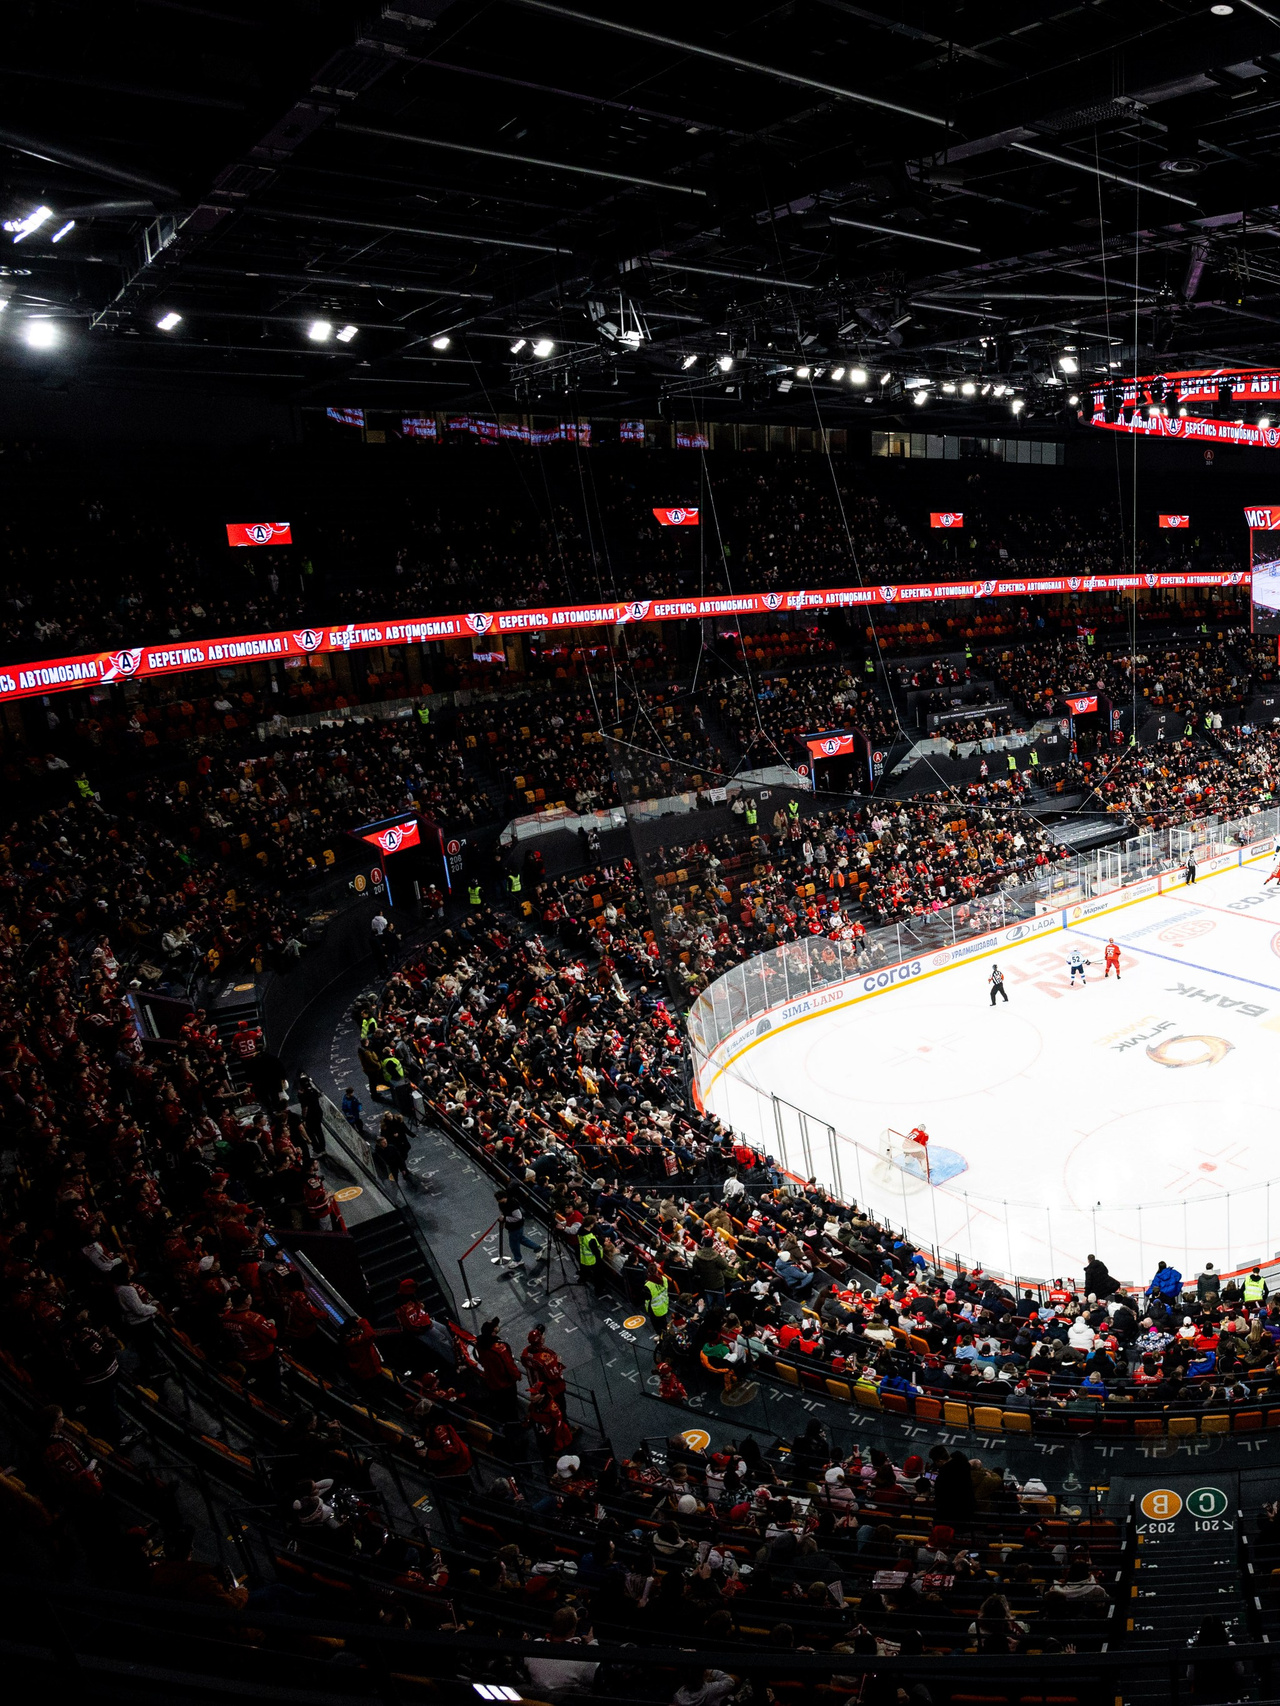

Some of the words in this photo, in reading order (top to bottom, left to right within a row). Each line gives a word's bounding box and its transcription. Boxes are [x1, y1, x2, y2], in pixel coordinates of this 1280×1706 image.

[1185, 422, 1216, 436] БЕРЕГИСЬ
[1219, 426, 1258, 441] АВТОМОБИЛЯ
[654, 602, 696, 616] БЕРЕГИСЬ
[700, 600, 753, 613] АВТОМОБИЛЯ
[787, 594, 823, 606] БЕРЕГИСЬ
[500, 613, 548, 628] БЕРЕГИСЬ
[552, 609, 614, 624] АВТОМОБИЛЯ
[330, 628, 382, 646] БЕРЕГИСЬ
[386, 620, 454, 640] АВТОМОБИЛЯ
[148, 649, 204, 668] БЕРЕГИСЬ
[208, 638, 282, 660] АВТОМОБИЛЯ
[20, 663, 97, 688] АВТОМОБИЛЯ
[452, 863, 463, 872] 207
[374, 884, 384, 894] 207
[1083, 903, 1108, 916] Маркет
[1032, 918, 1056, 932] LADA
[951, 937, 998, 959] УРАЛМАШЗАВОД
[782, 990, 844, 1020] SIMA-LAND
[1164, 982, 1269, 1017] БАНК
[239, 1040, 255, 1051] 58
[628, 1318, 642, 1328] B
[1153, 1495, 1168, 1514] B
[1199, 1493, 1216, 1513] C
[1149, 1522, 1174, 1533] 203
[1195, 1520, 1219, 1531] 201
